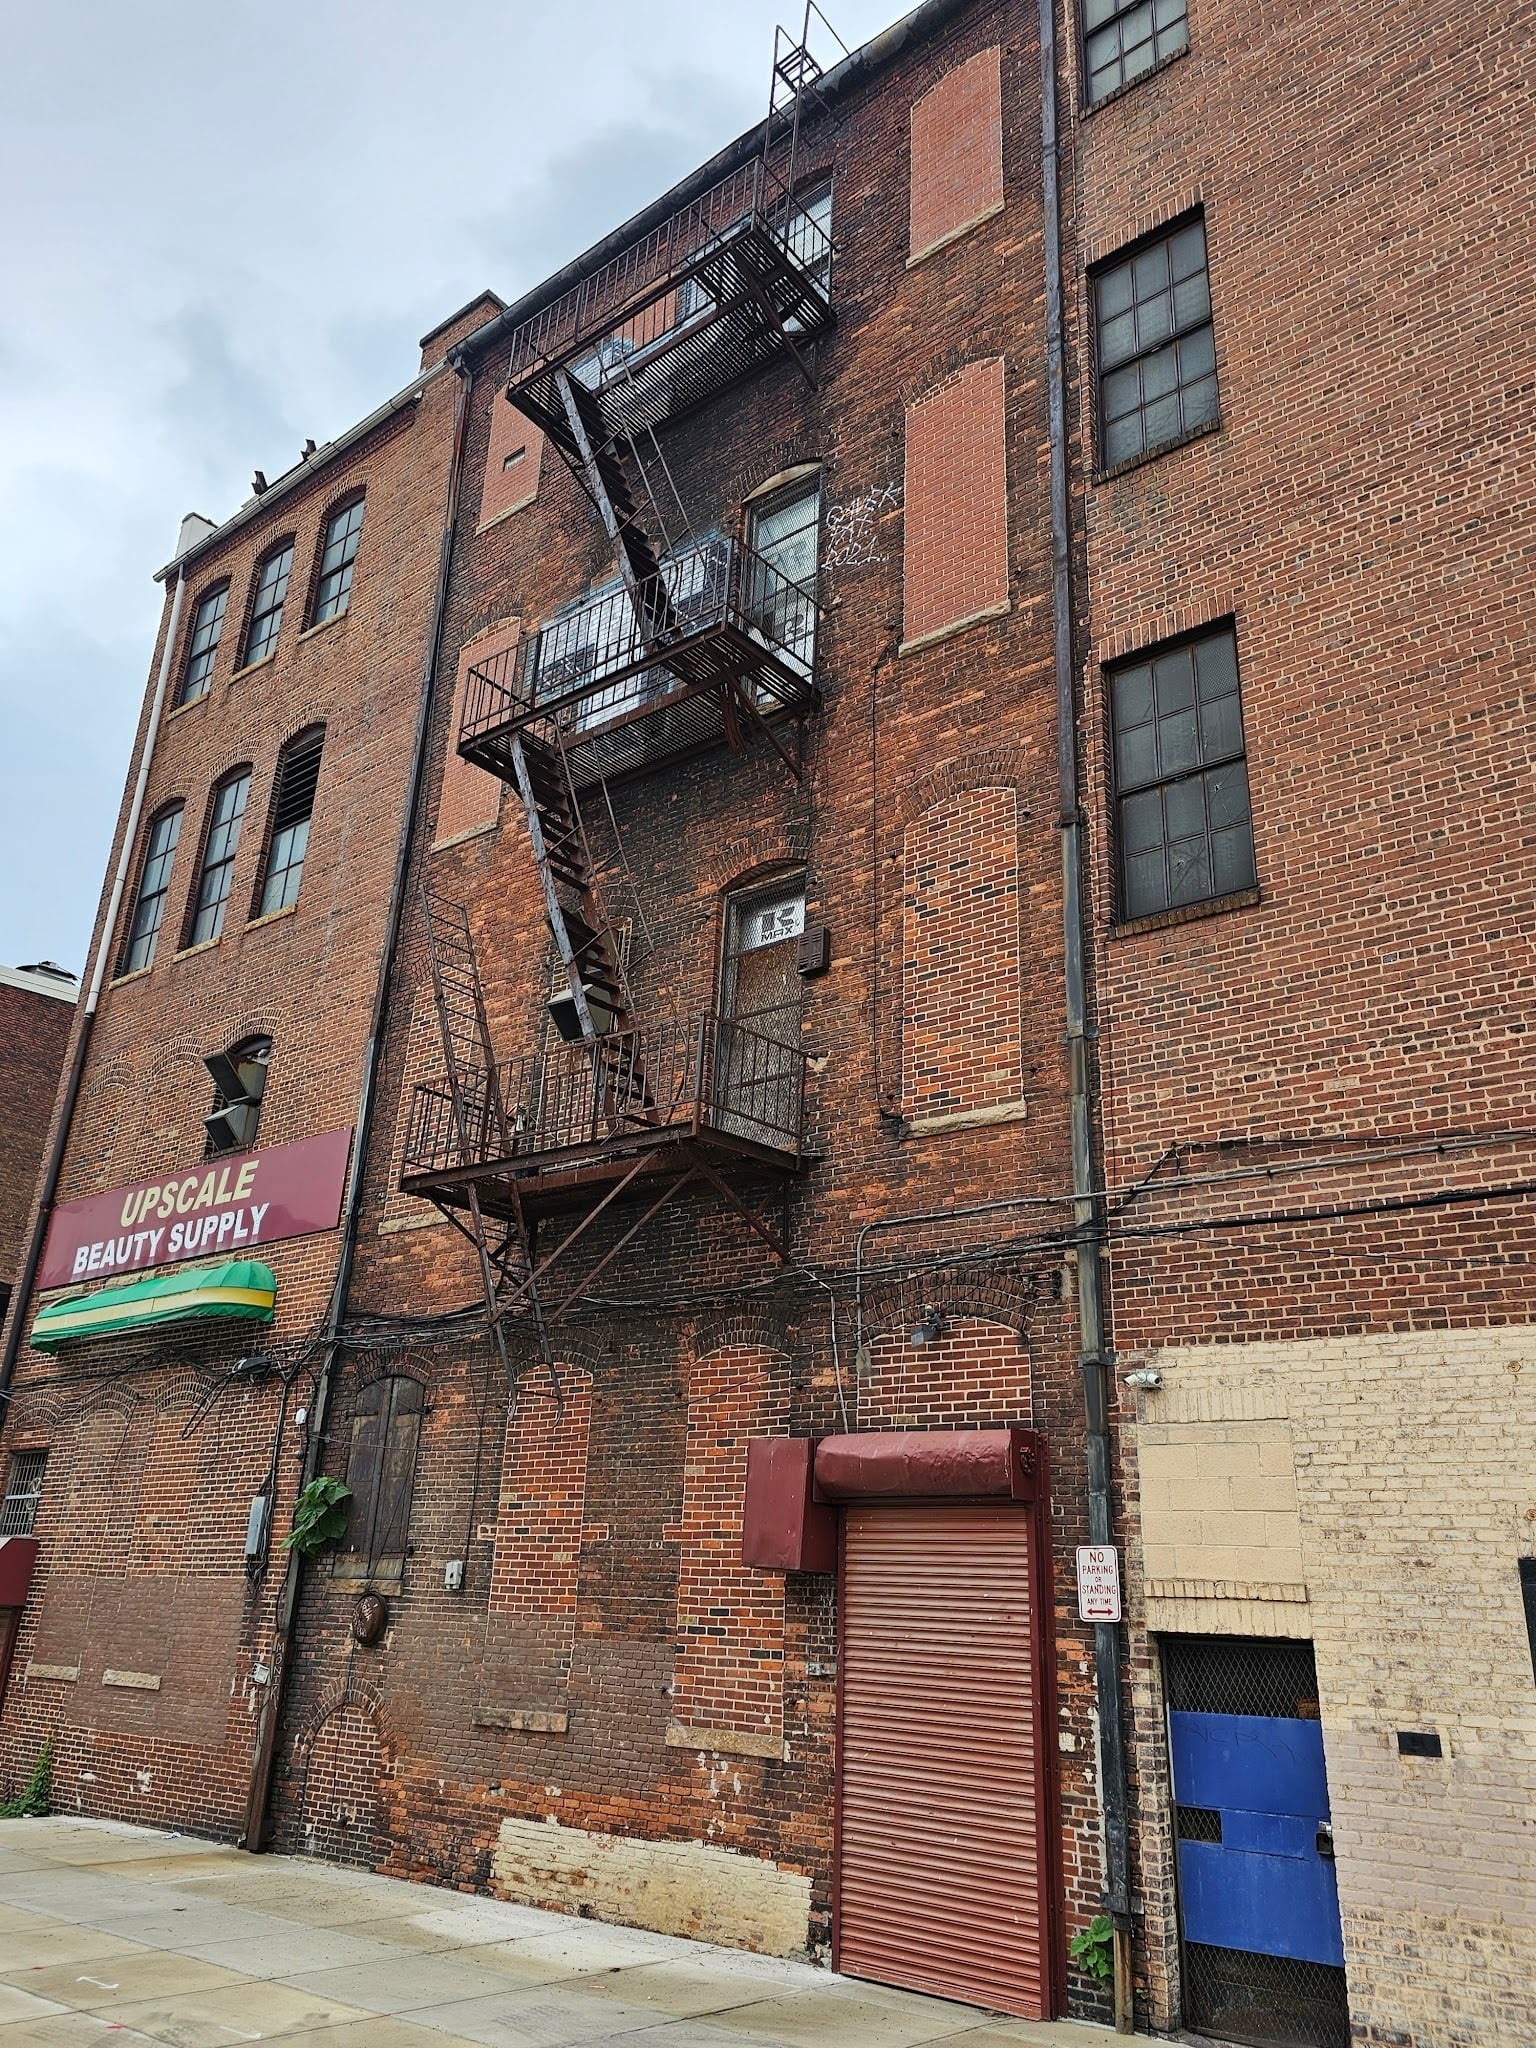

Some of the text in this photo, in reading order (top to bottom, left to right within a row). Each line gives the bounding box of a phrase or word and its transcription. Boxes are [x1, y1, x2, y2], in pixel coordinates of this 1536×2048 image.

[760, 925, 793, 942] MAX
[120, 1160, 260, 1228] UPSCALE
[72, 1203, 269, 1275] BEAUTY SUPPLY
[1089, 1551, 1105, 1563] NO
[1082, 1565, 1113, 1575] PARKING
[1081, 1584, 1117, 1595] STANDING
[1100, 1598, 1112, 1606] TIME
